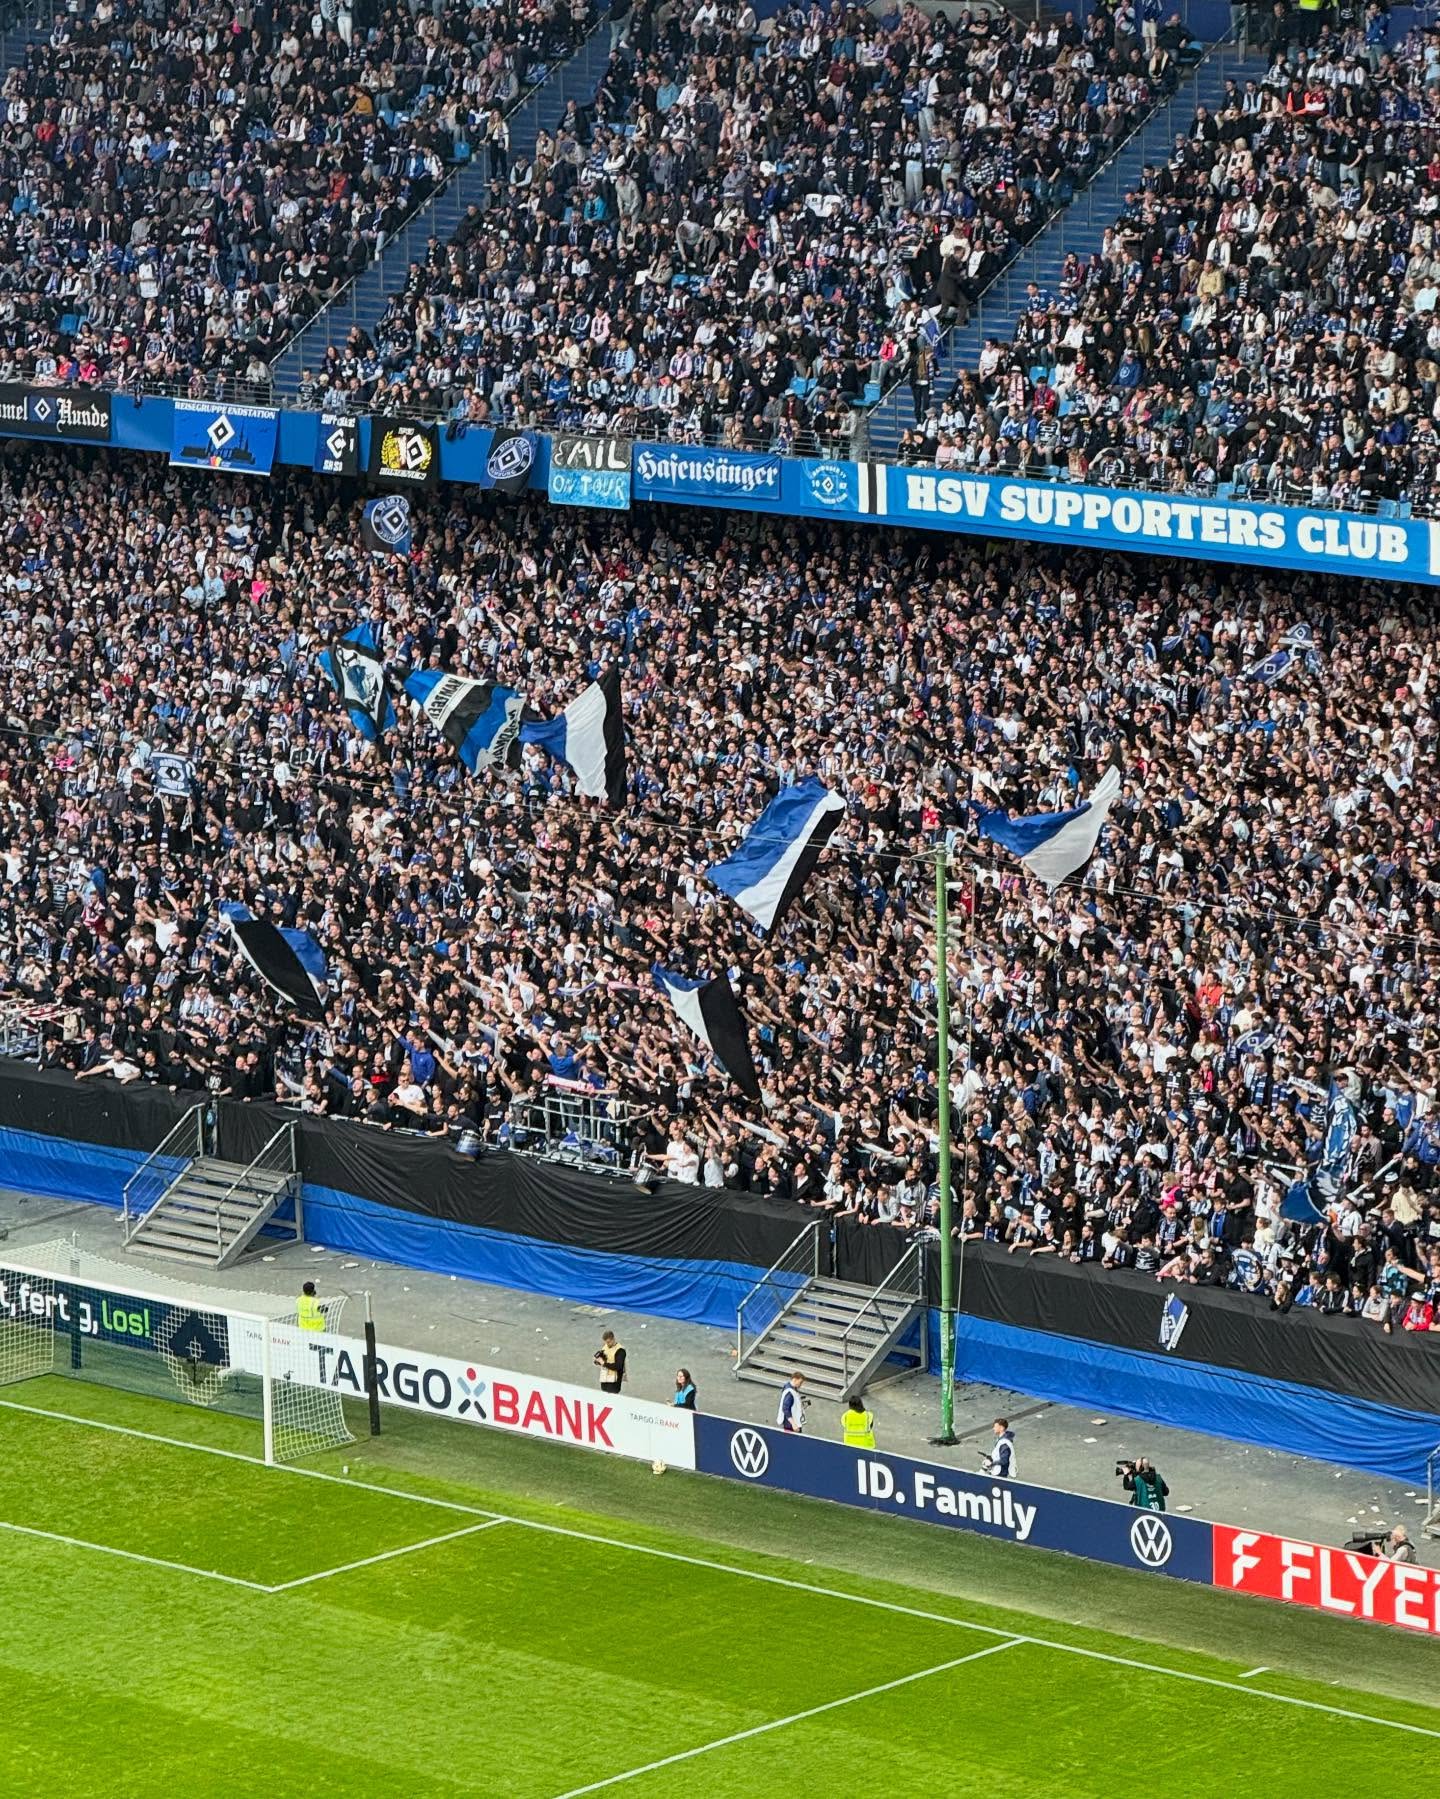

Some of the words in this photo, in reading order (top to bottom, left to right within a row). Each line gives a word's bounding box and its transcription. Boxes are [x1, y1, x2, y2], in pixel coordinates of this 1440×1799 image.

[56, 397, 109, 432] Hunde
[174, 401, 227, 415] REISEGRUPPE
[227, 407, 276, 419] ENDSTATION
[637, 451, 778, 491] Hafensänger
[906, 474, 990, 517] HSV
[1000, 485, 1285, 549] SUPPORTERS
[1297, 516, 1409, 563] CLUB
[19, 1283, 98, 1335] fertg,
[101, 1300, 151, 1338] los!
[492, 1381, 614, 1448] BANK
[857, 1459, 906, 1504] ID.
[914, 1471, 1037, 1540] Family
